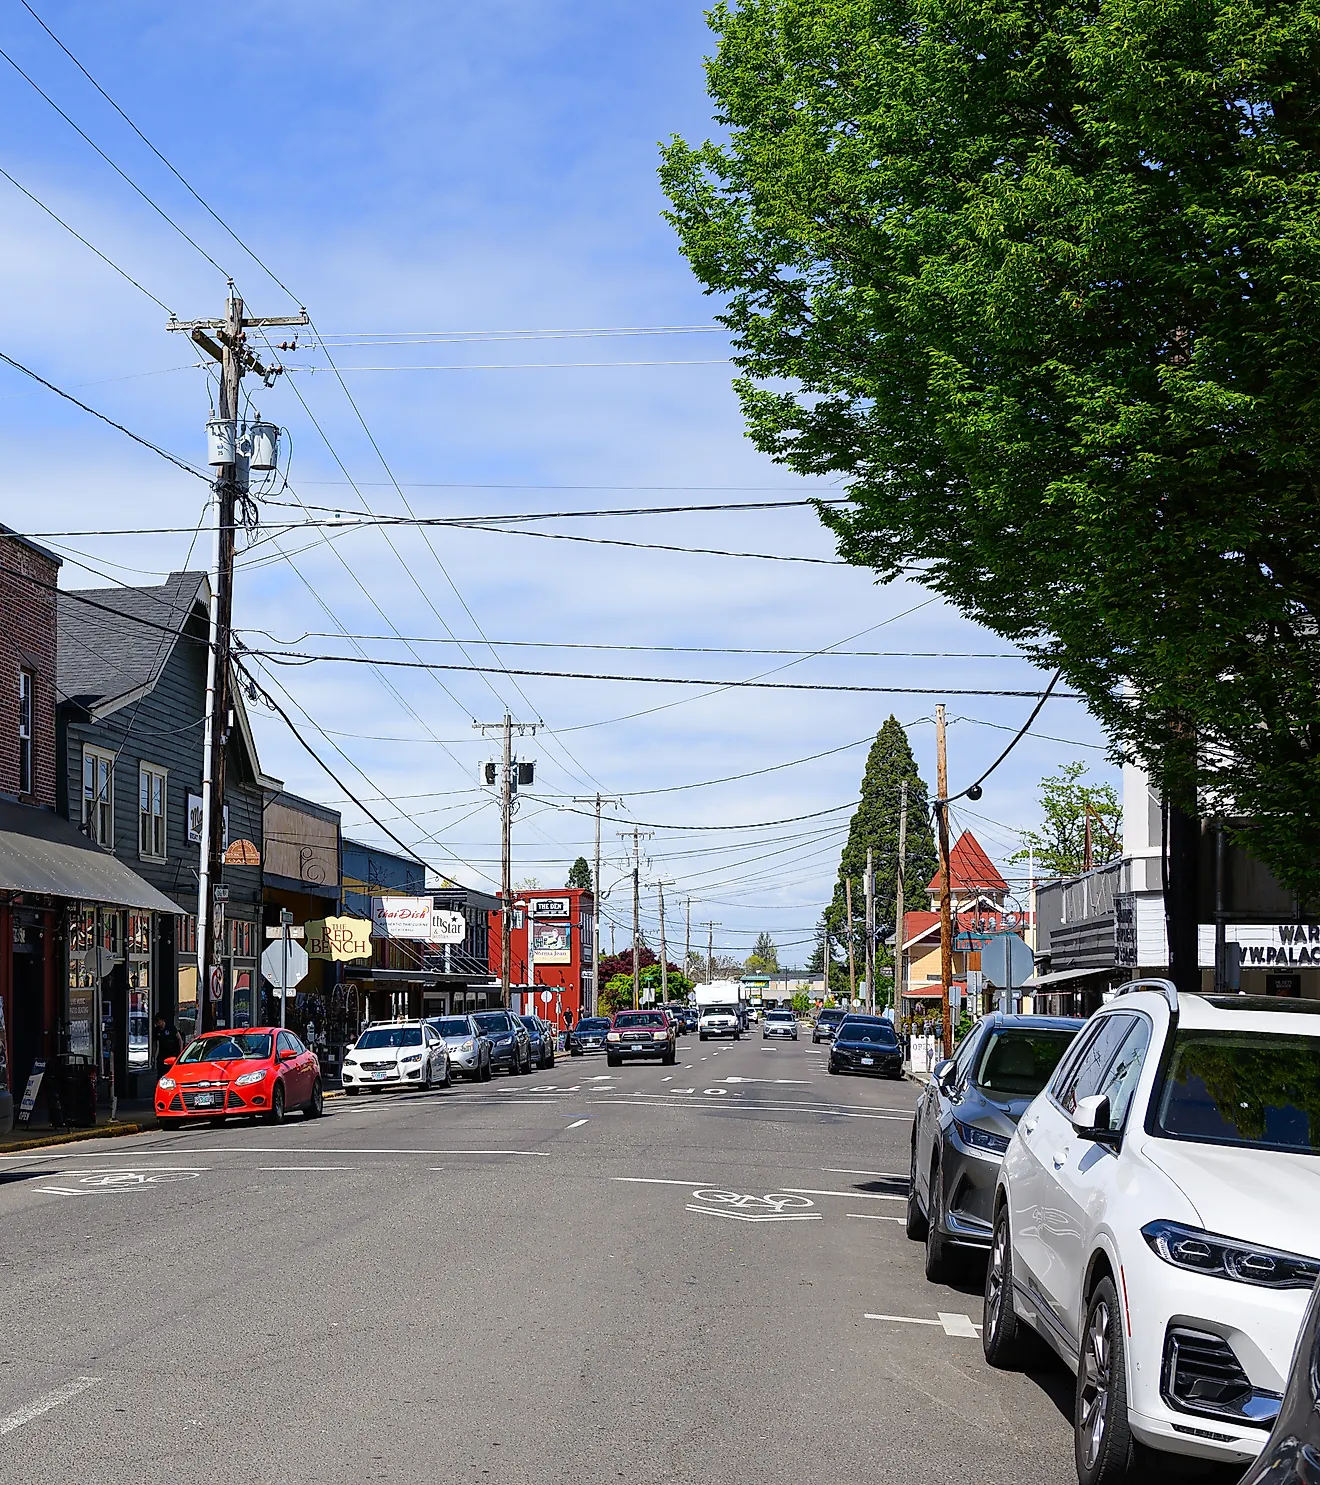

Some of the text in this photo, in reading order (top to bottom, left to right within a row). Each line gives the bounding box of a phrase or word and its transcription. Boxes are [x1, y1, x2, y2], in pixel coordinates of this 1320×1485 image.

[377, 908, 426, 919] Thai Dish
[321, 926, 353, 942] RED
[441, 920, 463, 934] Star
[310, 938, 366, 953] BENCH
